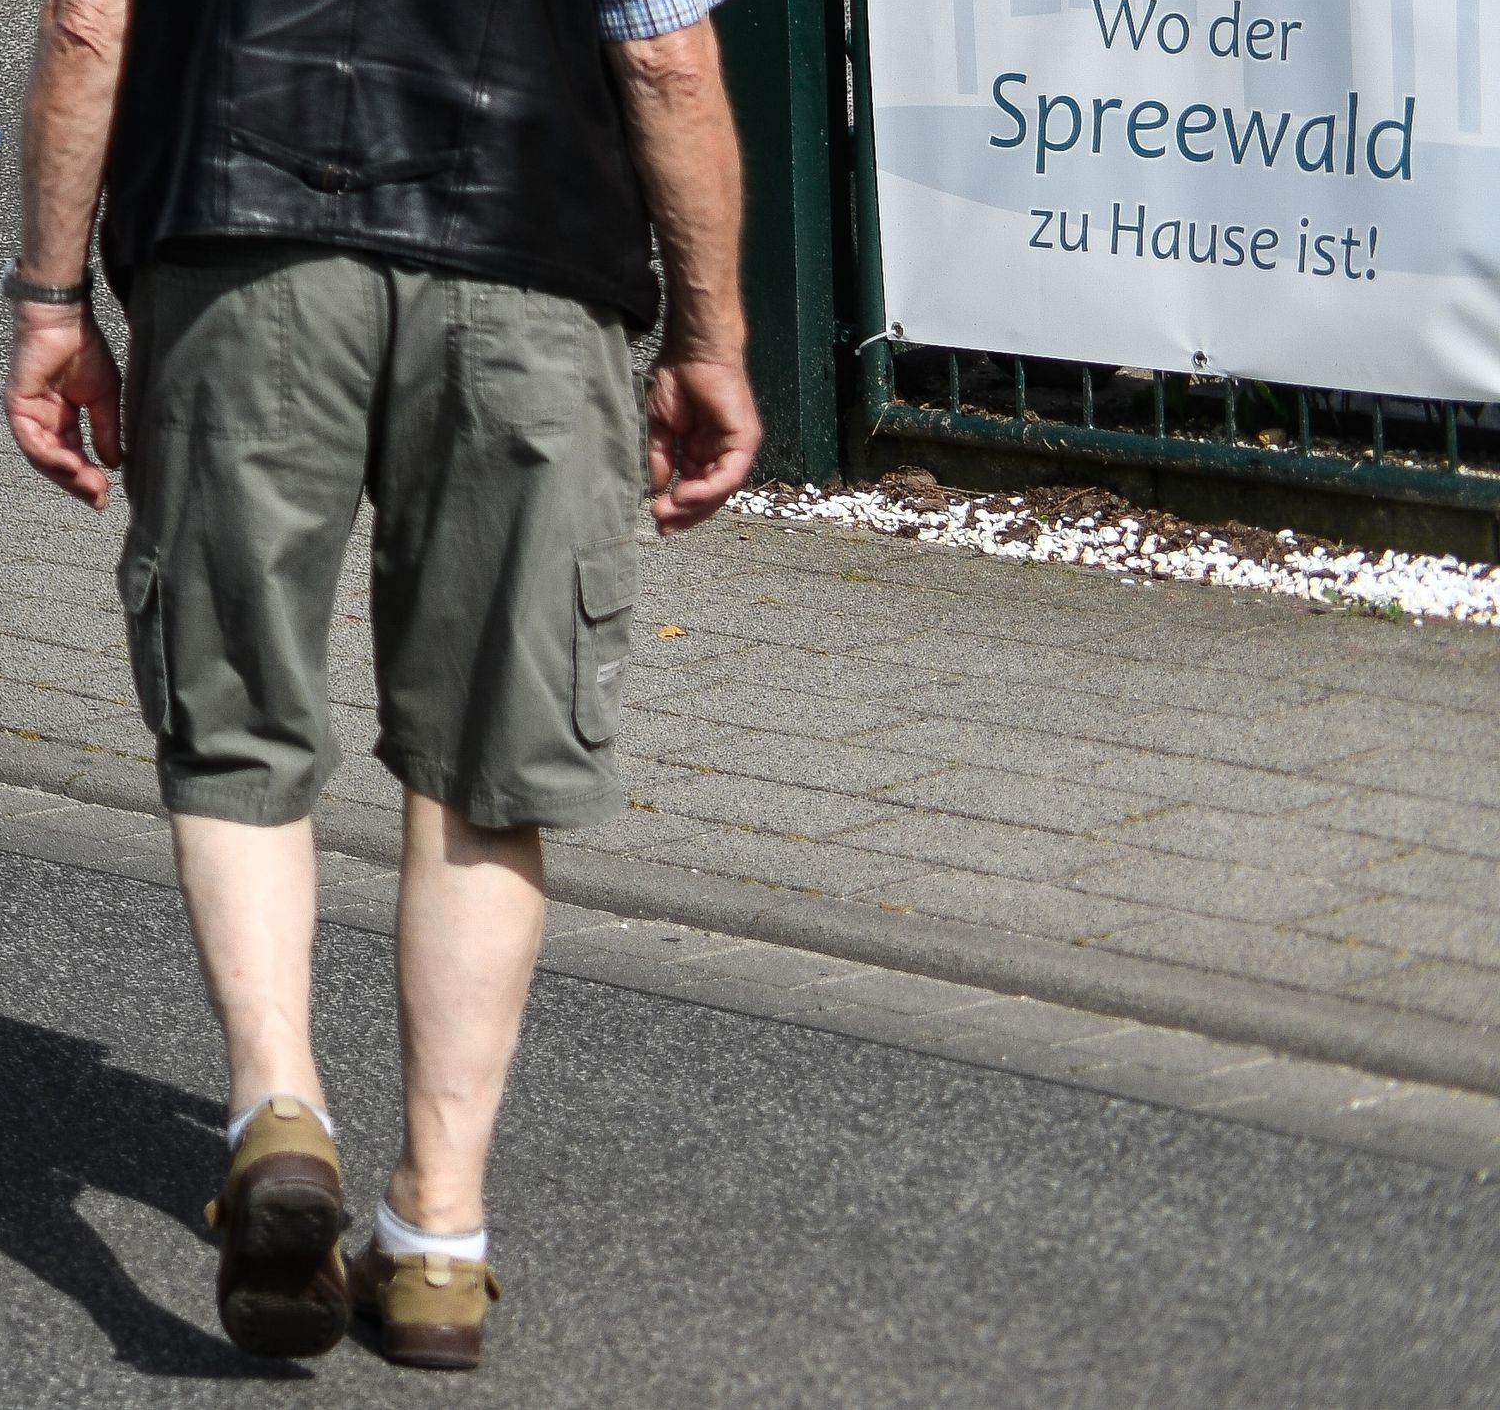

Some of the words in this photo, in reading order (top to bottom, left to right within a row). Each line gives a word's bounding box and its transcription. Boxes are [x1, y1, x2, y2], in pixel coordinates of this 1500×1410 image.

[1209, 0, 1304, 62] der
[989, 72, 1417, 182] Spreewald
[1029, 207, 1090, 253] zu
[1111, 203, 1280, 271] Hause
[1297, 217, 1379, 281] ist!
